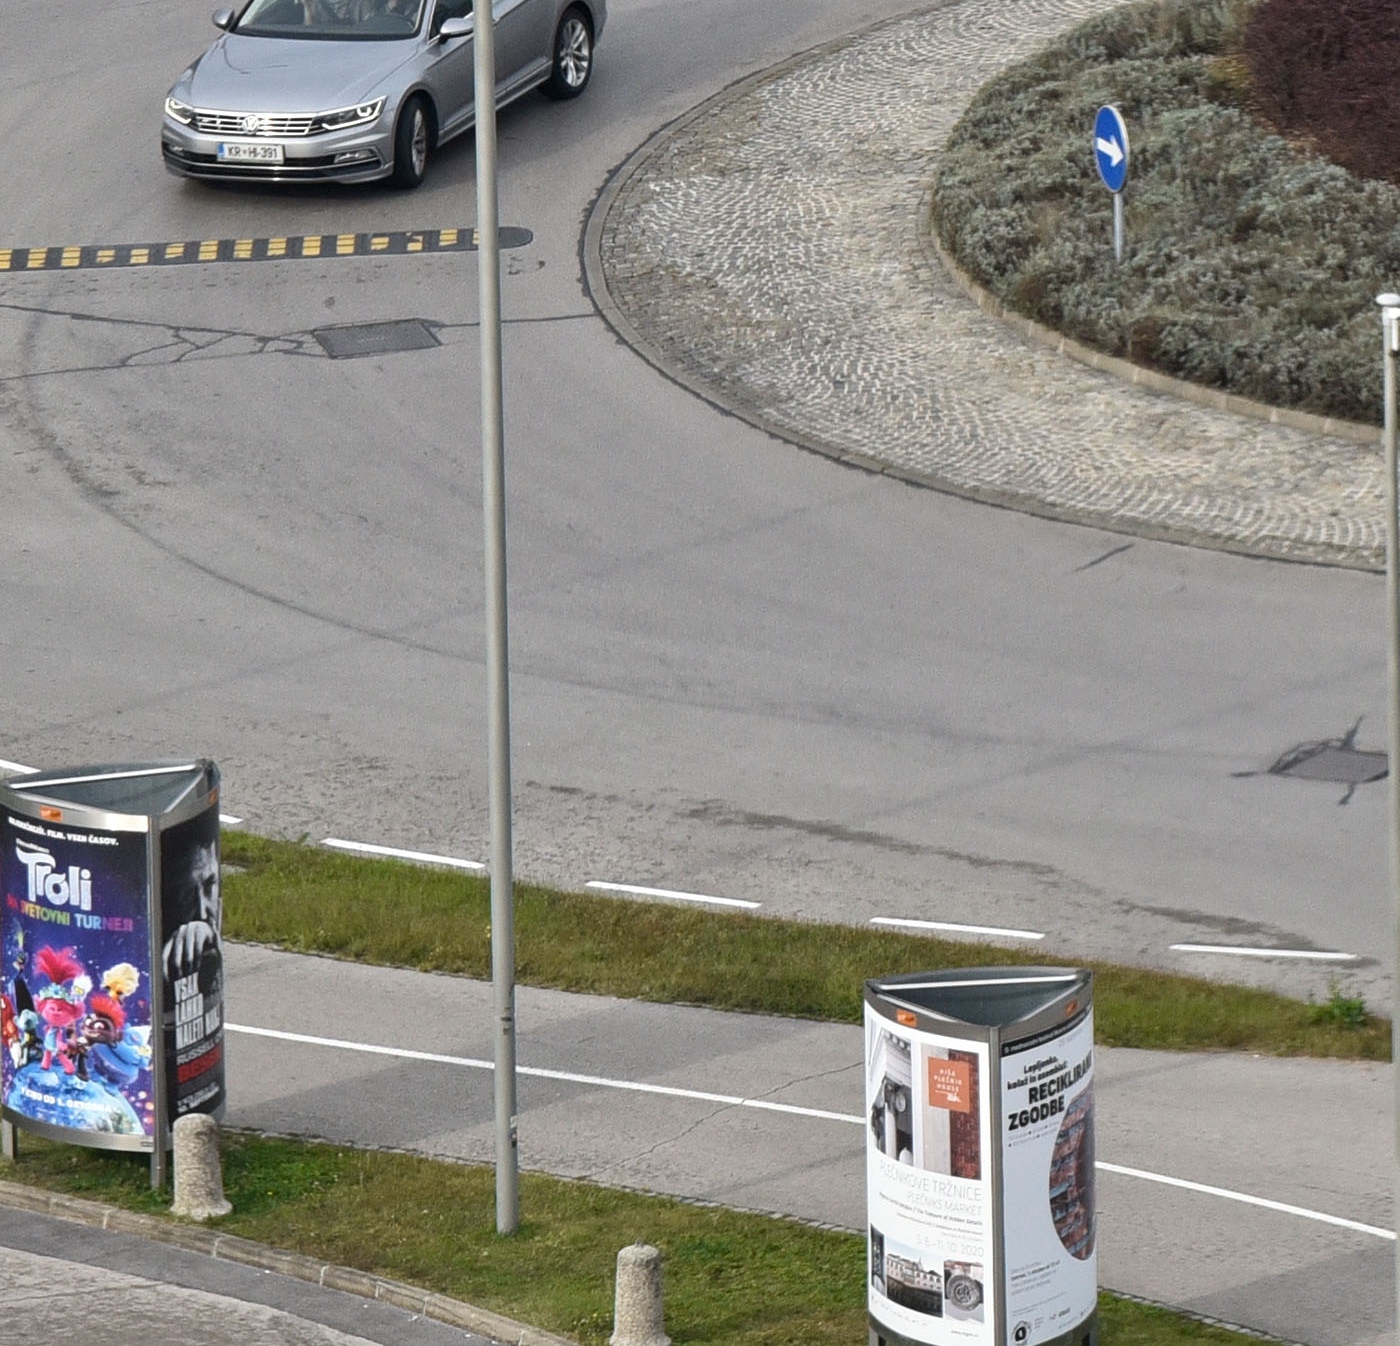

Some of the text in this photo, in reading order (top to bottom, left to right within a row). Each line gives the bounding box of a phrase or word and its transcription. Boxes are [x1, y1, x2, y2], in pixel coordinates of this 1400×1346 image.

[15, 845, 92, 911] Troli
[1008, 1094, 1065, 1131] ZGODBE
[932, 1179, 983, 1202] TRŽNICE
